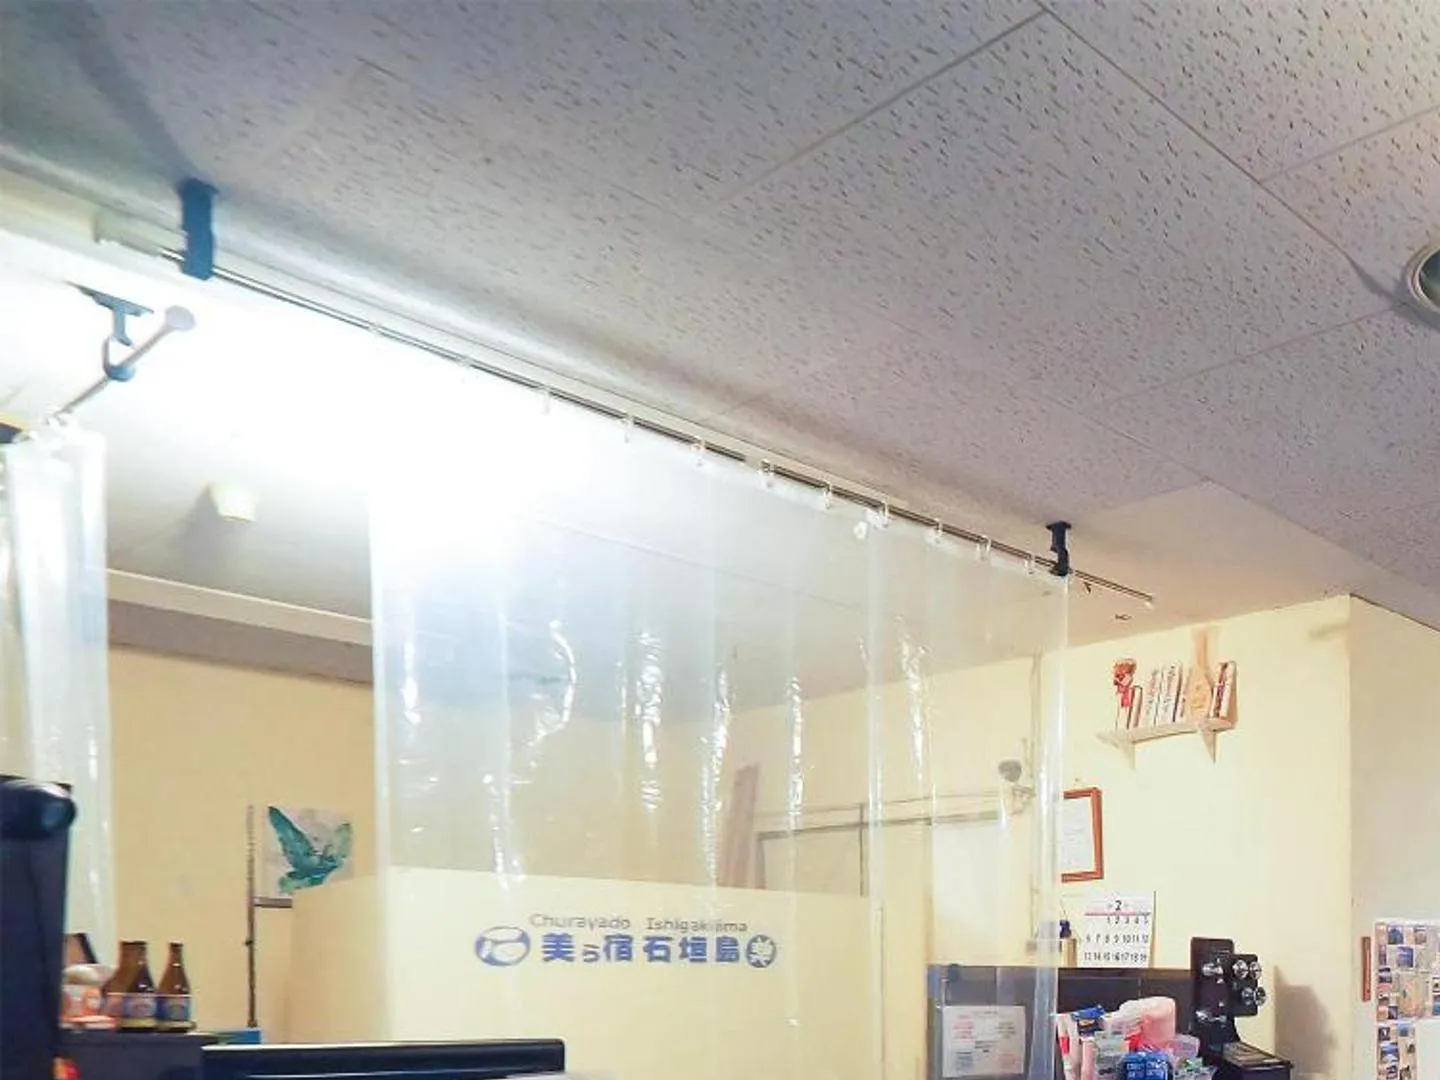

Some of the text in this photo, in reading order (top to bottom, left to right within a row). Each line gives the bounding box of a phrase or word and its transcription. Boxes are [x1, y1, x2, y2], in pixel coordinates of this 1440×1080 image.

[1115, 900, 1122, 911] 2
[529, 912, 632, 931] Churayado
[541, 932, 741, 964] 美ら宿石垣島
